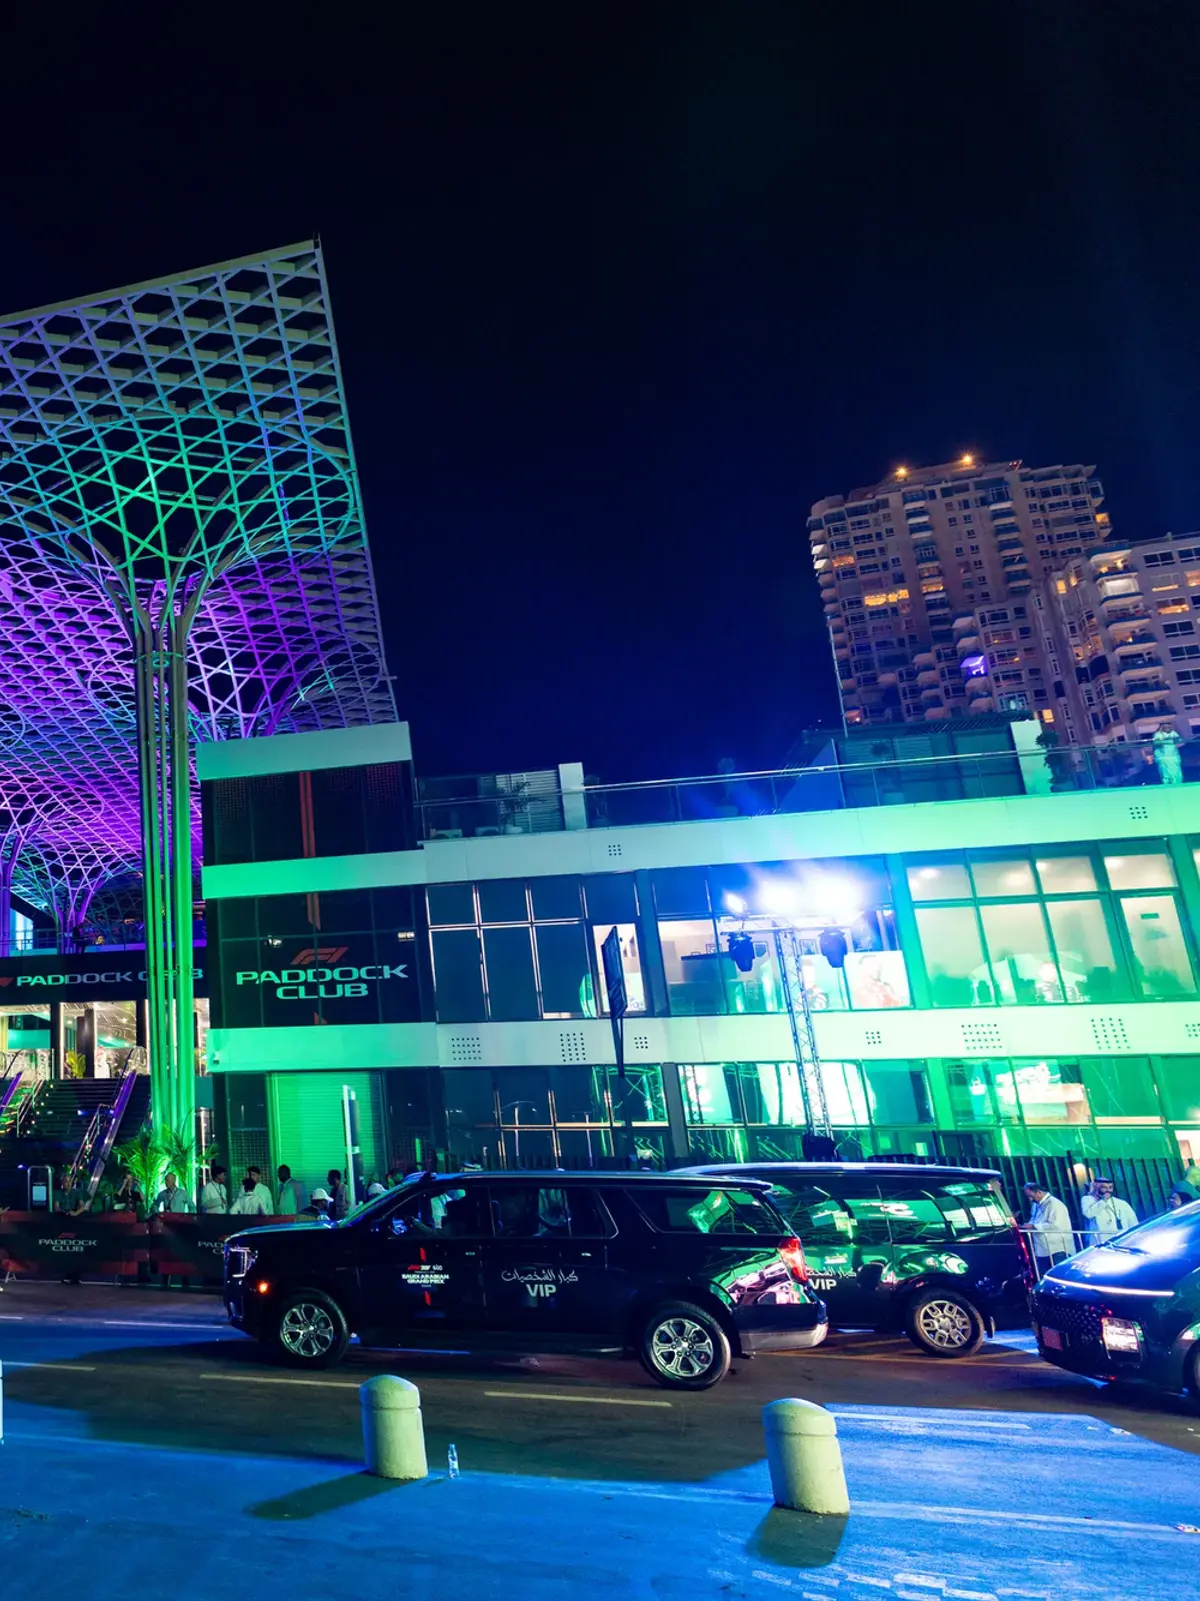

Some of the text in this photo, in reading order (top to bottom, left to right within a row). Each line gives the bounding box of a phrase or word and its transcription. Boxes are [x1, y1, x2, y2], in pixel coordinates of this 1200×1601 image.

[16, 971, 132, 986] PADDOCK
[138, 968, 204, 981] CB
[236, 964, 408, 985] PADDOCK
[276, 983, 369, 1000] CLUB
[38, 1238, 97, 1246] PADDOCK
[501, 1268, 579, 1284] كبار الشخصيات
[526, 1284, 557, 1297] VIP
[808, 1279, 837, 1290] VIP
